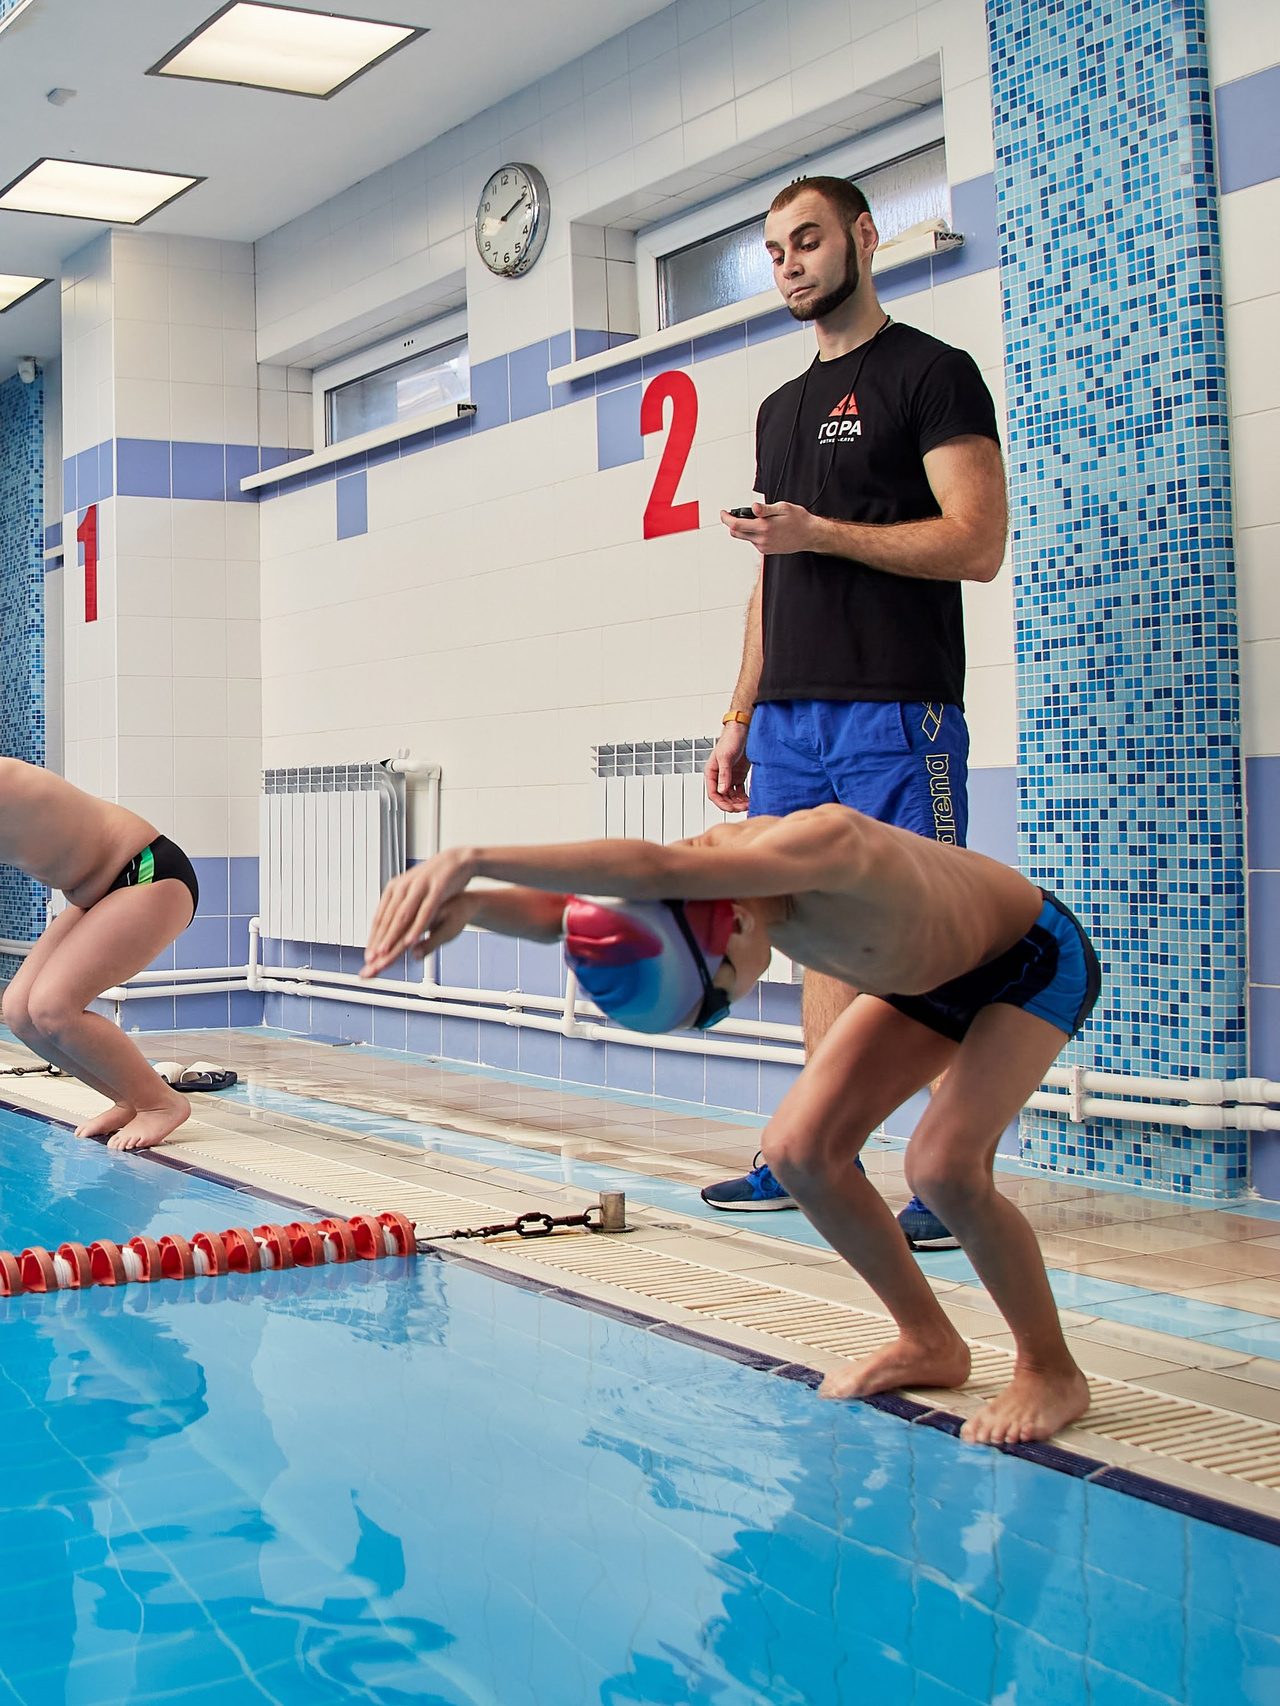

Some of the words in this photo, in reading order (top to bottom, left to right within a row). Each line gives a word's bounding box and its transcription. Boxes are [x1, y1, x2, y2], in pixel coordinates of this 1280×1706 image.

[501, 175, 509, 186] 12
[492, 185, 497, 196] 11
[522, 225, 528, 235] 4
[485, 241, 491, 252] 8
[514, 242, 521, 253] 5
[493, 252, 498, 263] 7
[504, 252, 510, 263] 6
[817, 420, 862, 440] ГОРА
[640, 370, 699, 540] 2
[77, 505, 97, 622] 1
[925, 753, 957, 847] arena
